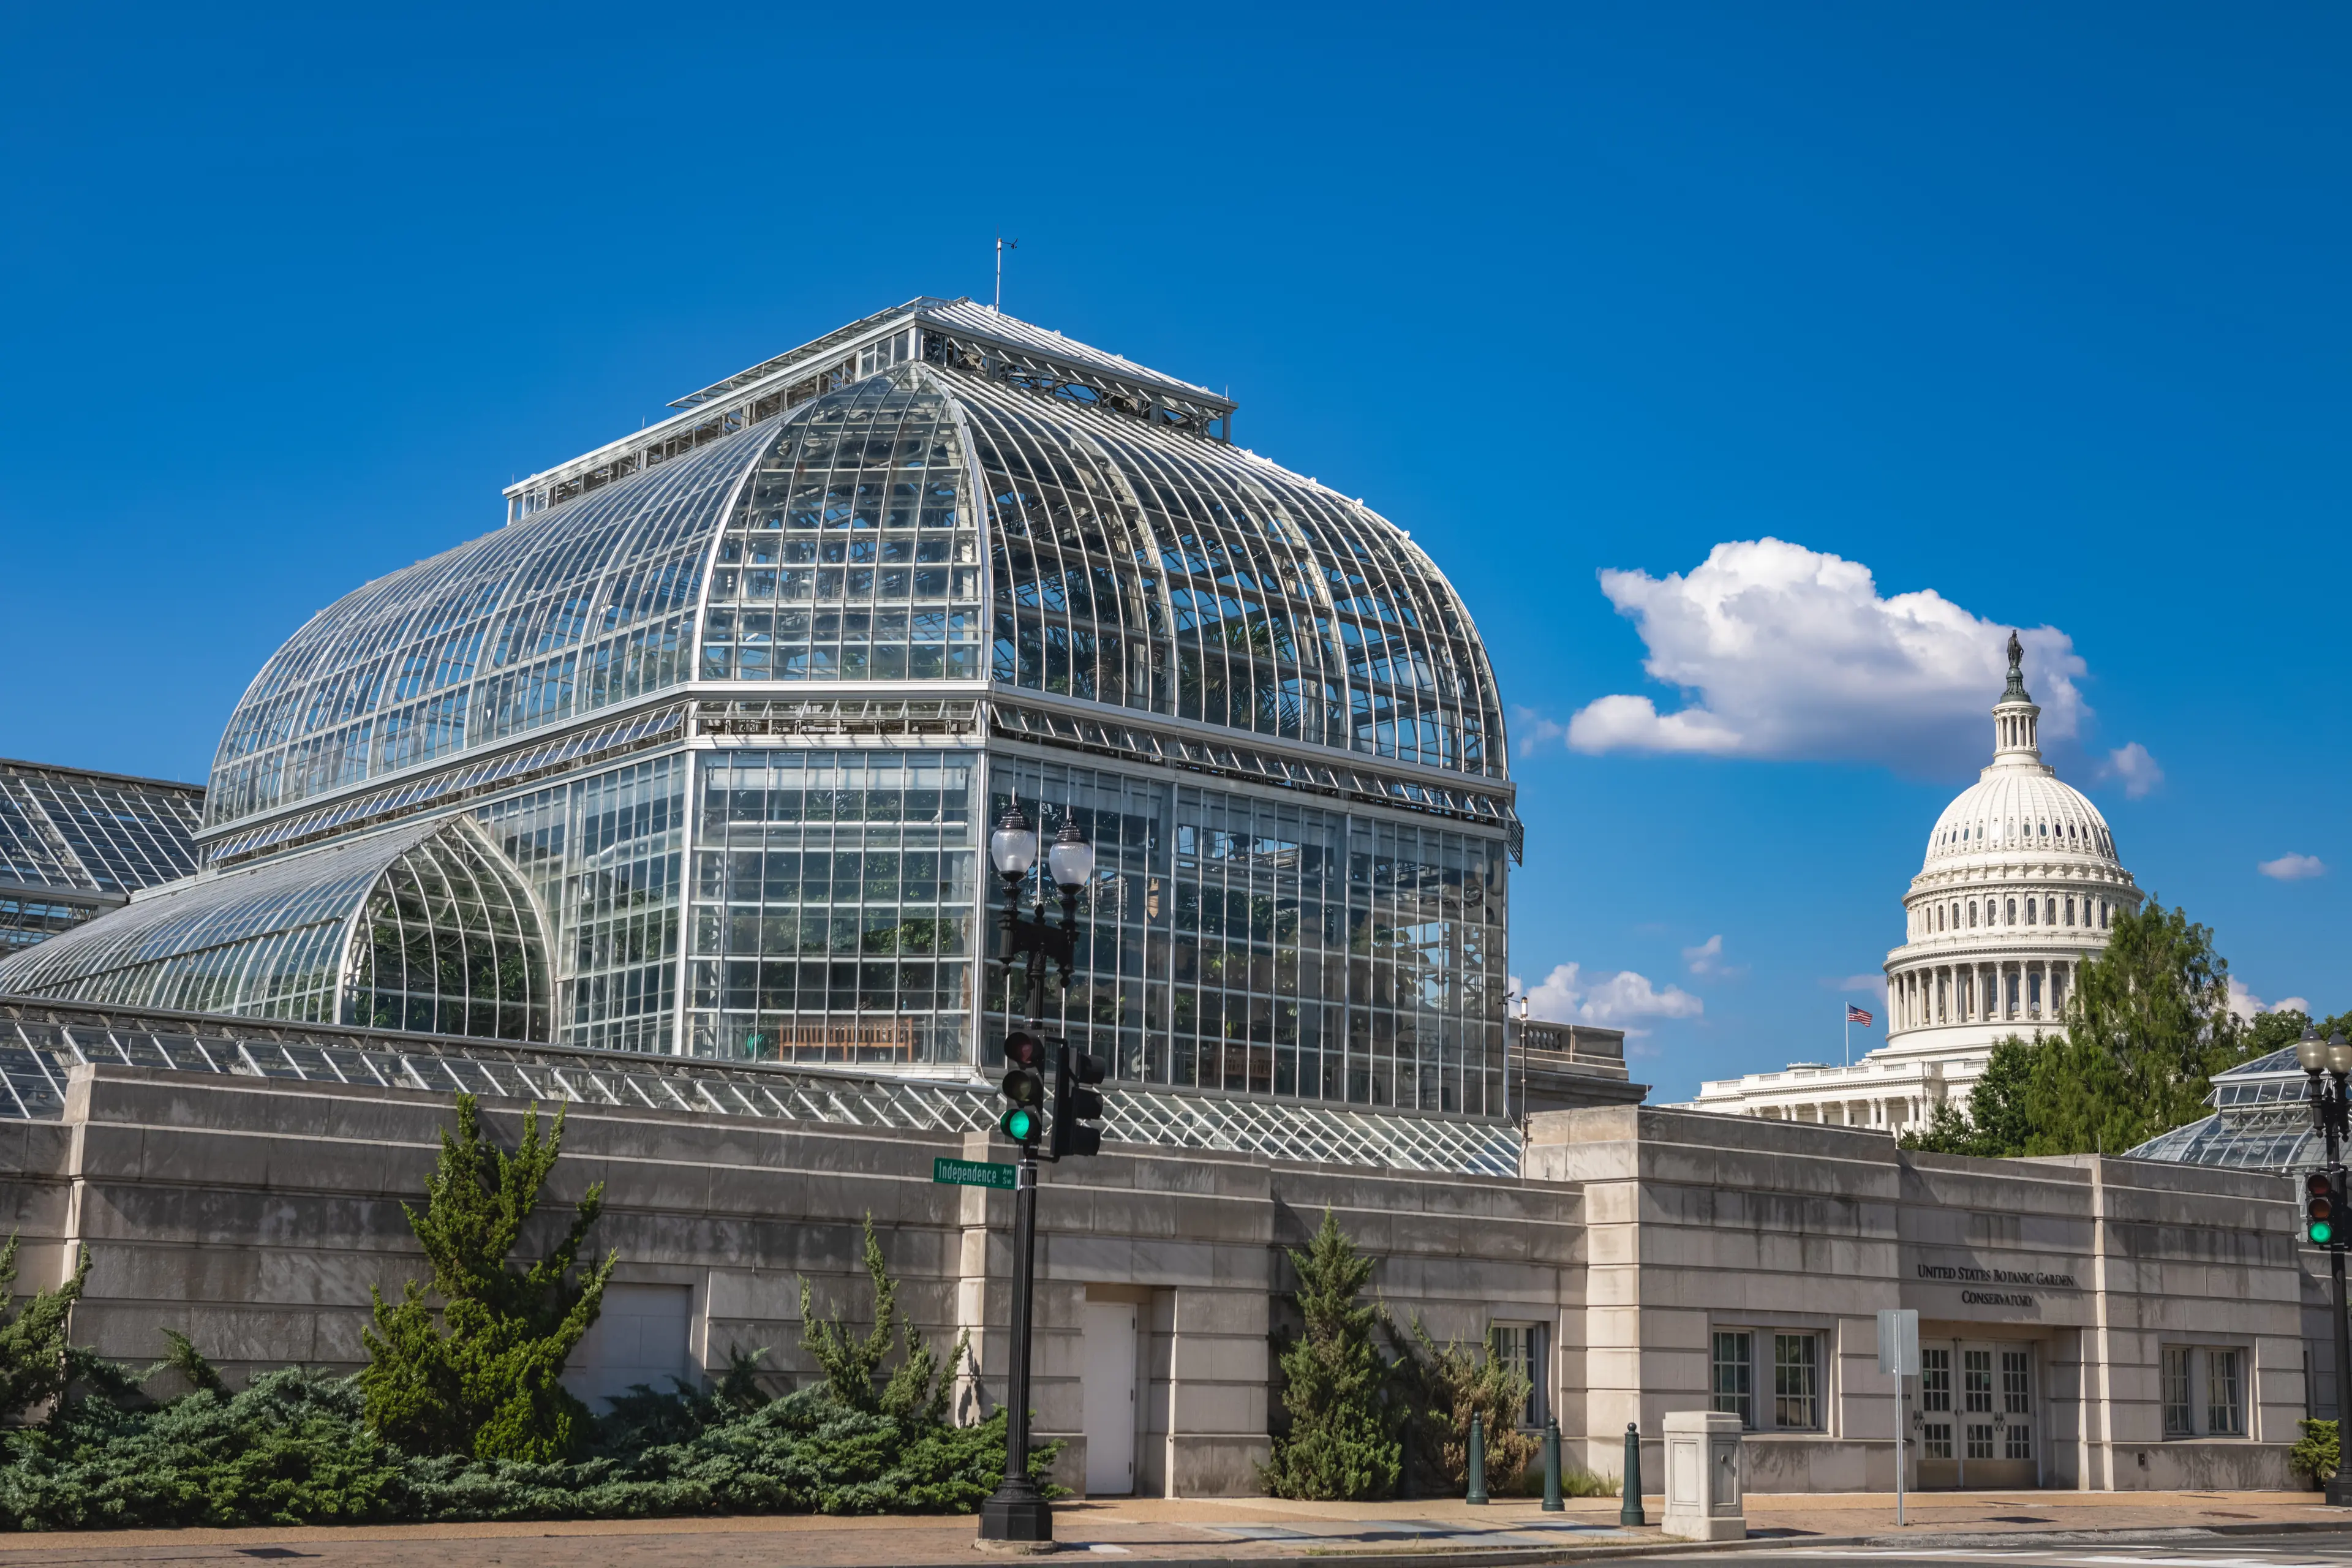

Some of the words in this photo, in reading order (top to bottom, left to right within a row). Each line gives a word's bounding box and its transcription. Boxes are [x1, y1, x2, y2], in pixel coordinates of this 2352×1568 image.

[938, 1161, 997, 1184] Independence
[1003, 1167, 1012, 1175] Ave
[1918, 1264, 1956, 1279] UNITED
[1958, 1267, 1991, 1281] STATES
[1993, 1270, 2034, 1284] BOTANIC
[2037, 1272, 2074, 1286] GARDEN
[1962, 1291, 2034, 1307] CONSERVATORY
